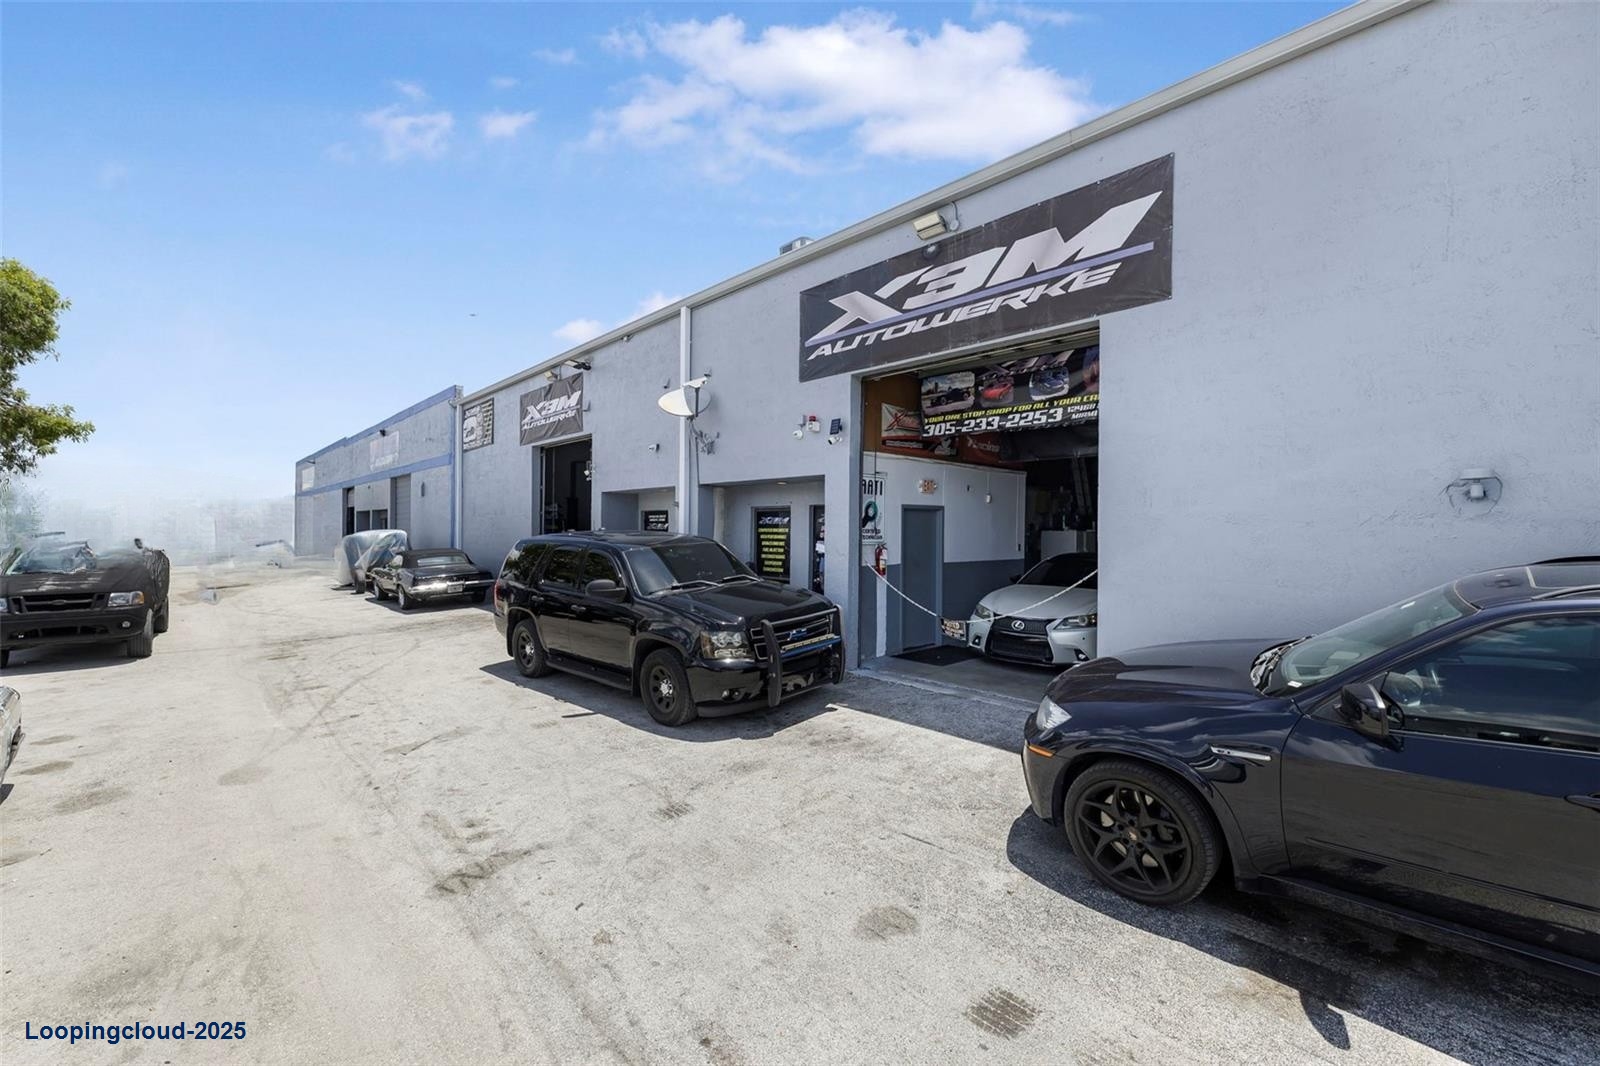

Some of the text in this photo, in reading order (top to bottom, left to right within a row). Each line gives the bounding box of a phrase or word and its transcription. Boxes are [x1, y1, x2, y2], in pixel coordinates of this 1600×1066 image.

[807, 262, 1122, 361] AUTOWERKE
[962, 410, 985, 419] STOP
[985, 406, 1012, 416] SHOP
[1012, 404, 1032, 412] FOR
[1033, 401, 1050, 410] ALL
[1053, 396, 1082, 406] YOUR
[1083, 393, 1099, 402] CA
[922, 407, 1064, 437] 305-233-2253
